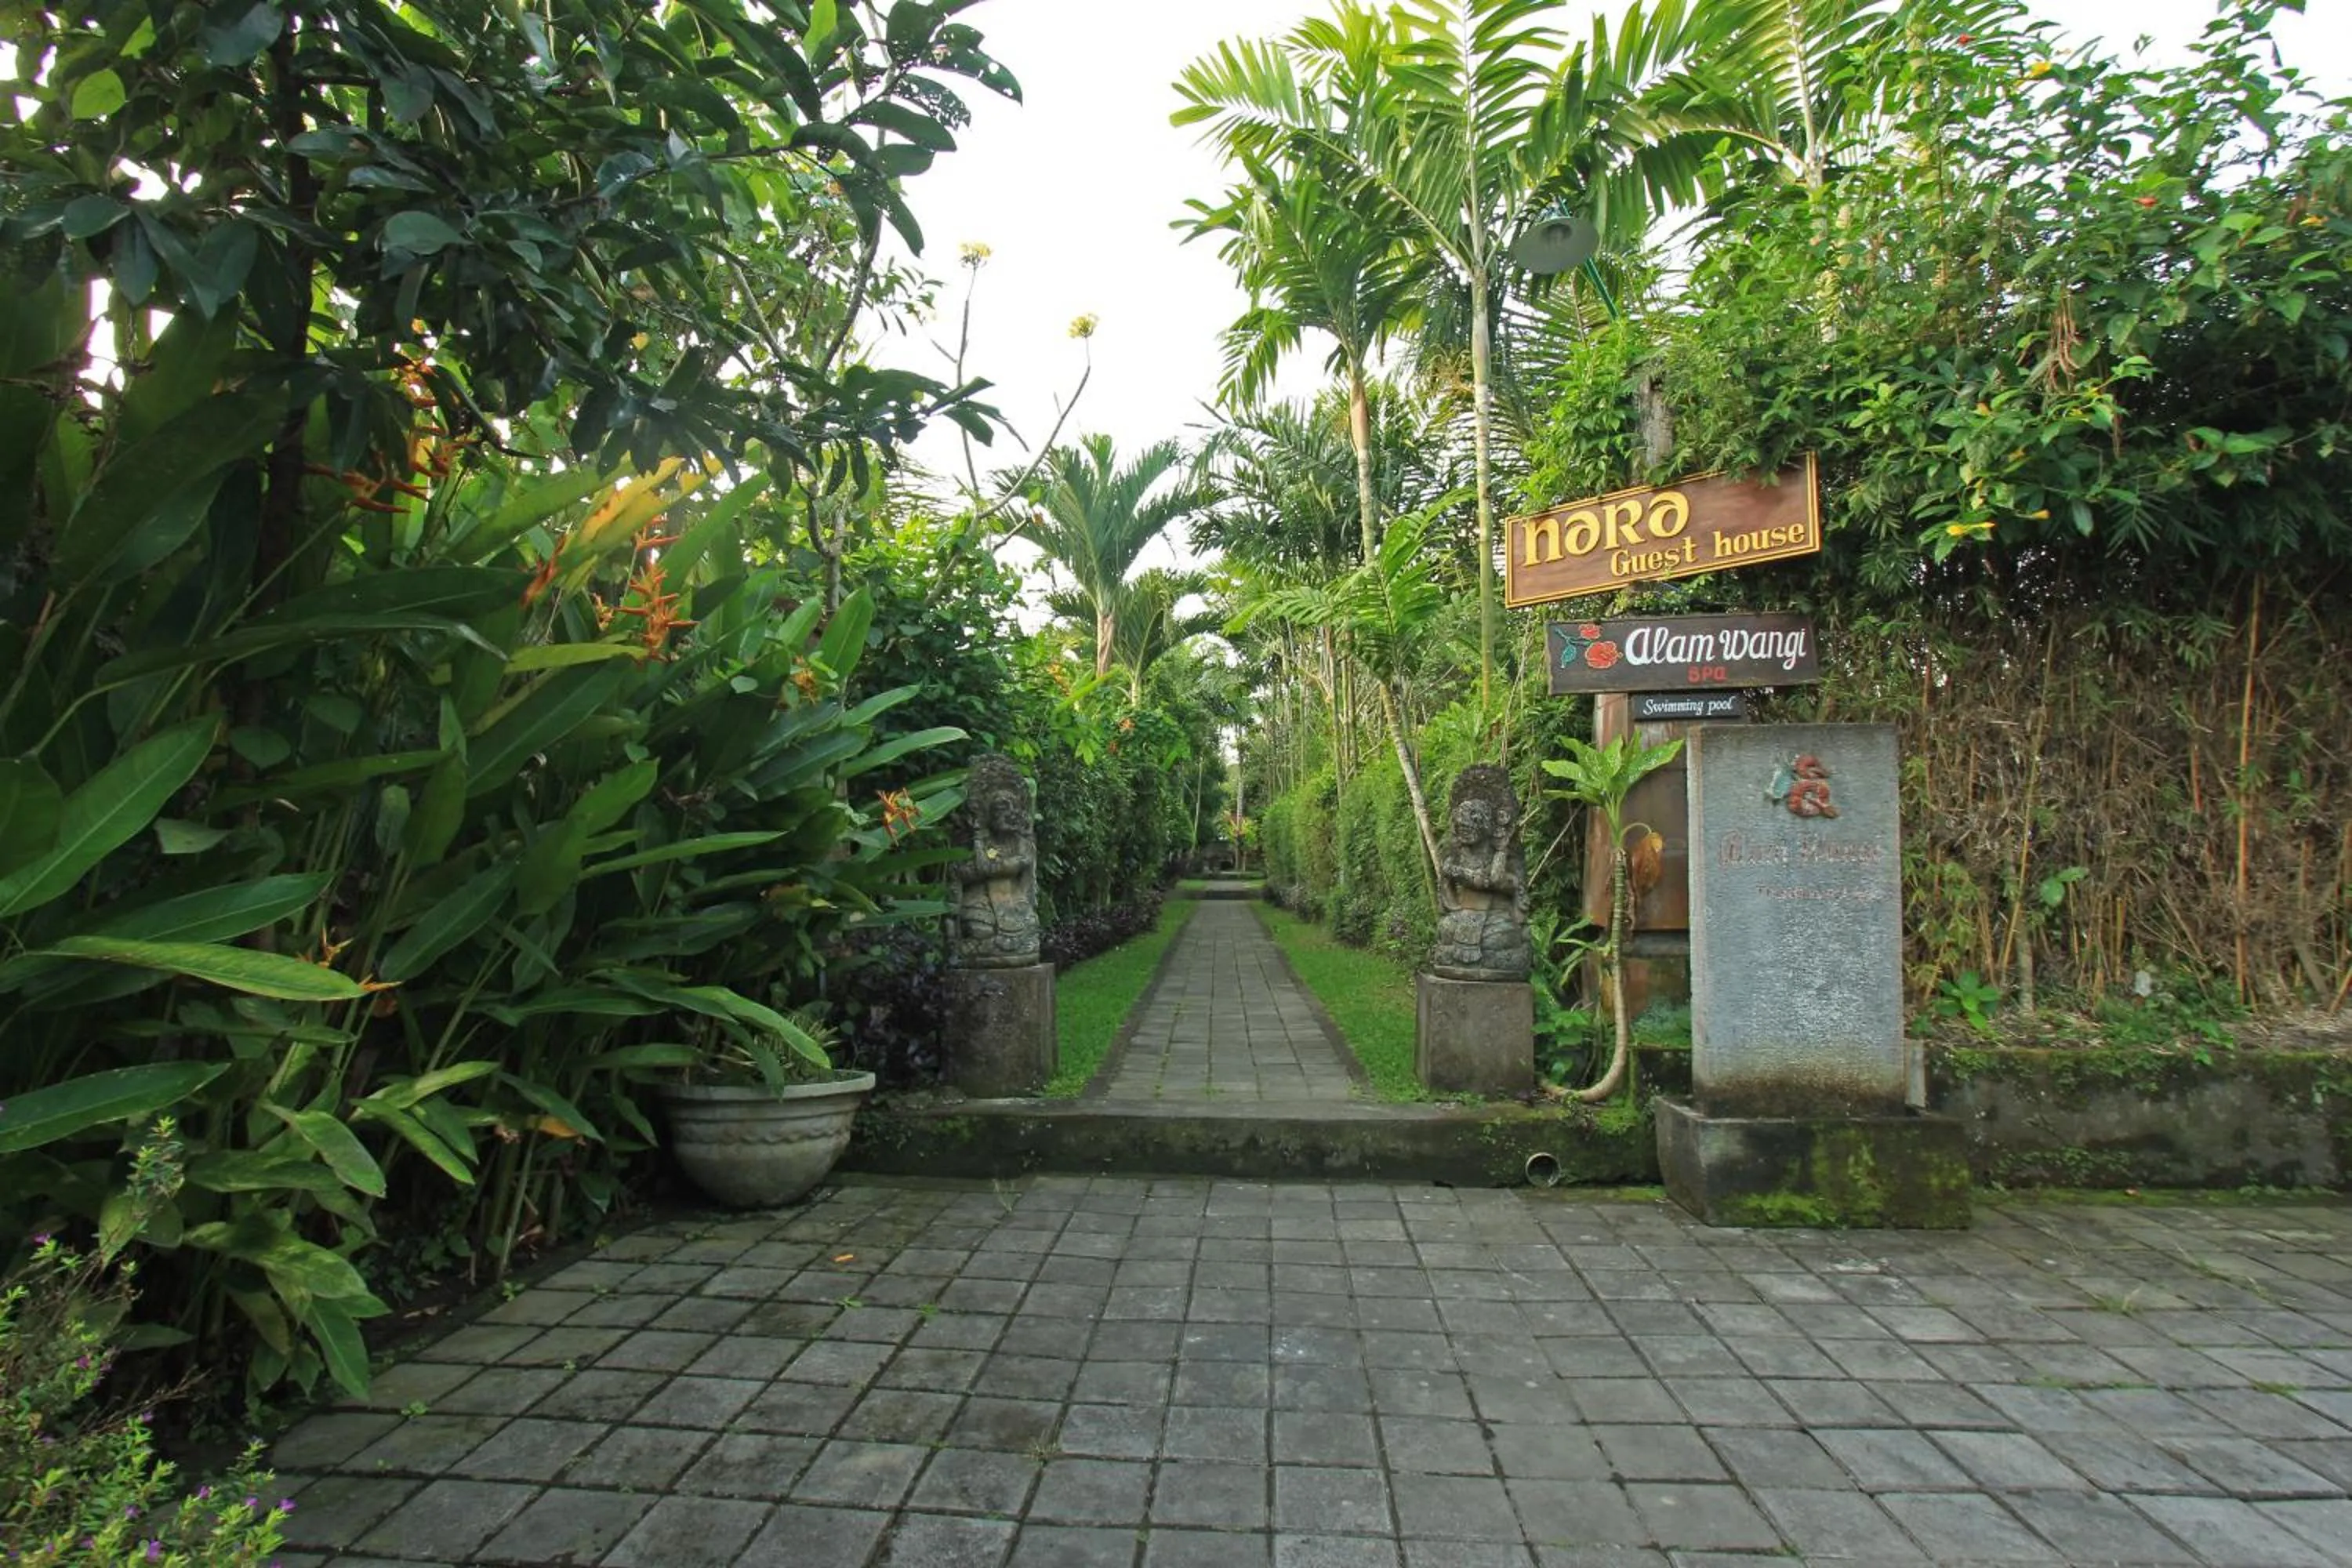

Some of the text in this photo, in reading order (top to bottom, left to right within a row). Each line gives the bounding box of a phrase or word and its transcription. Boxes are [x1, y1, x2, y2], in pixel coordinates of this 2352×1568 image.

[1610, 521, 1806, 577] Guest house
[1643, 695, 1735, 716] Swimming pool
